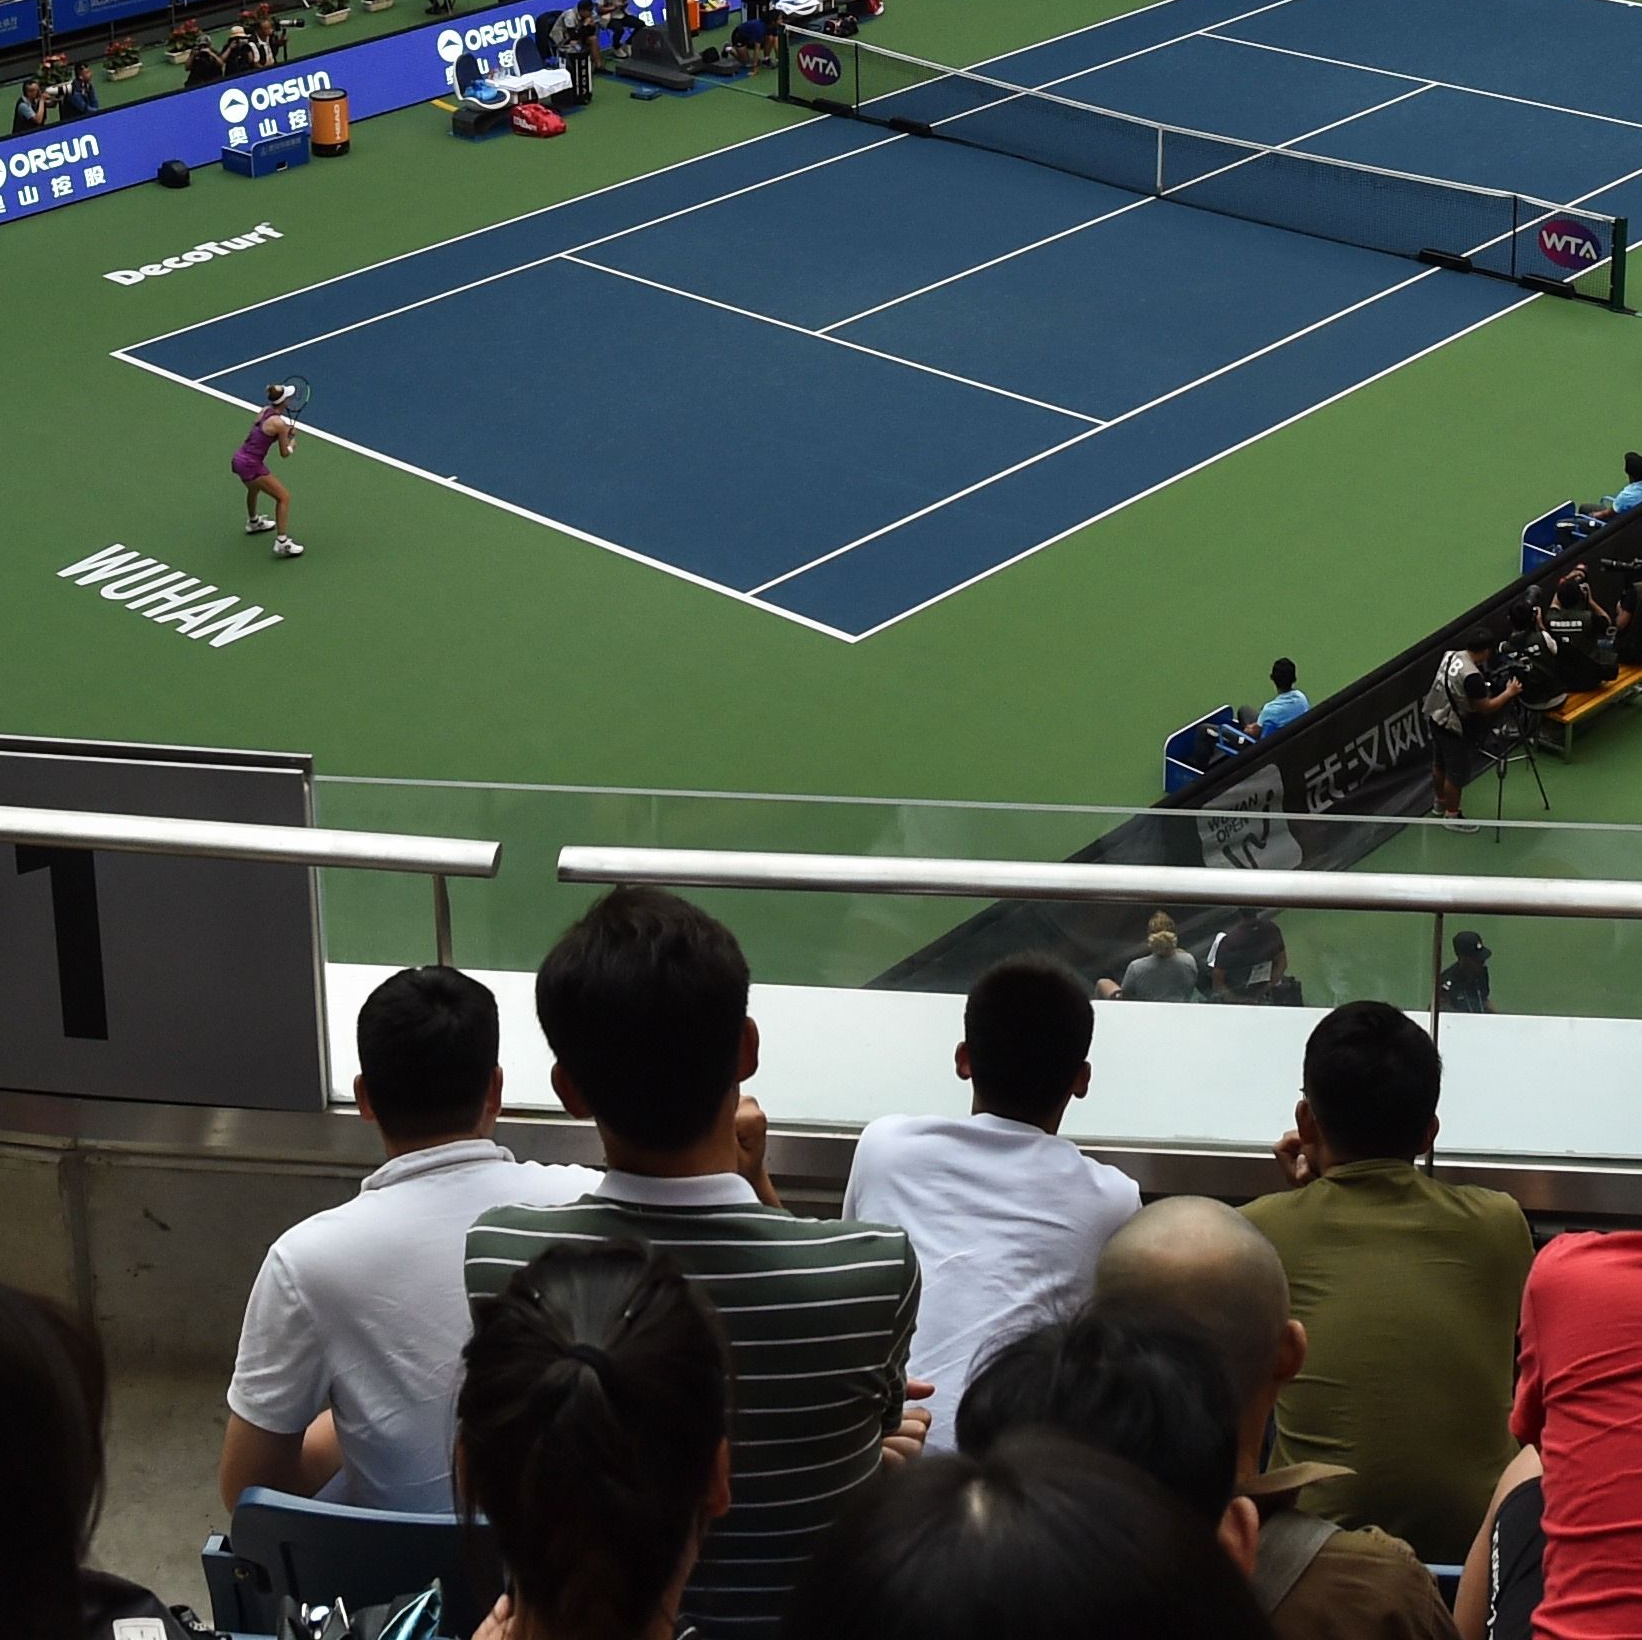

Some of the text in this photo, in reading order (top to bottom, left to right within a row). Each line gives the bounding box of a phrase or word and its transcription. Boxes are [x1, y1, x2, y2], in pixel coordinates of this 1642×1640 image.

[464, 13, 537, 47] ORSUN
[799, 53, 839, 78] WTA
[251, 70, 331, 111] ORSUN
[332, 104, 341, 142] HEAD
[9, 134, 99, 177] ORSUN
[103, 221, 285, 287] DecoTurf
[1540, 228, 1602, 262] WTA
[57, 543, 285, 649] WUHAN
[16, 846, 109, 1040] 1
